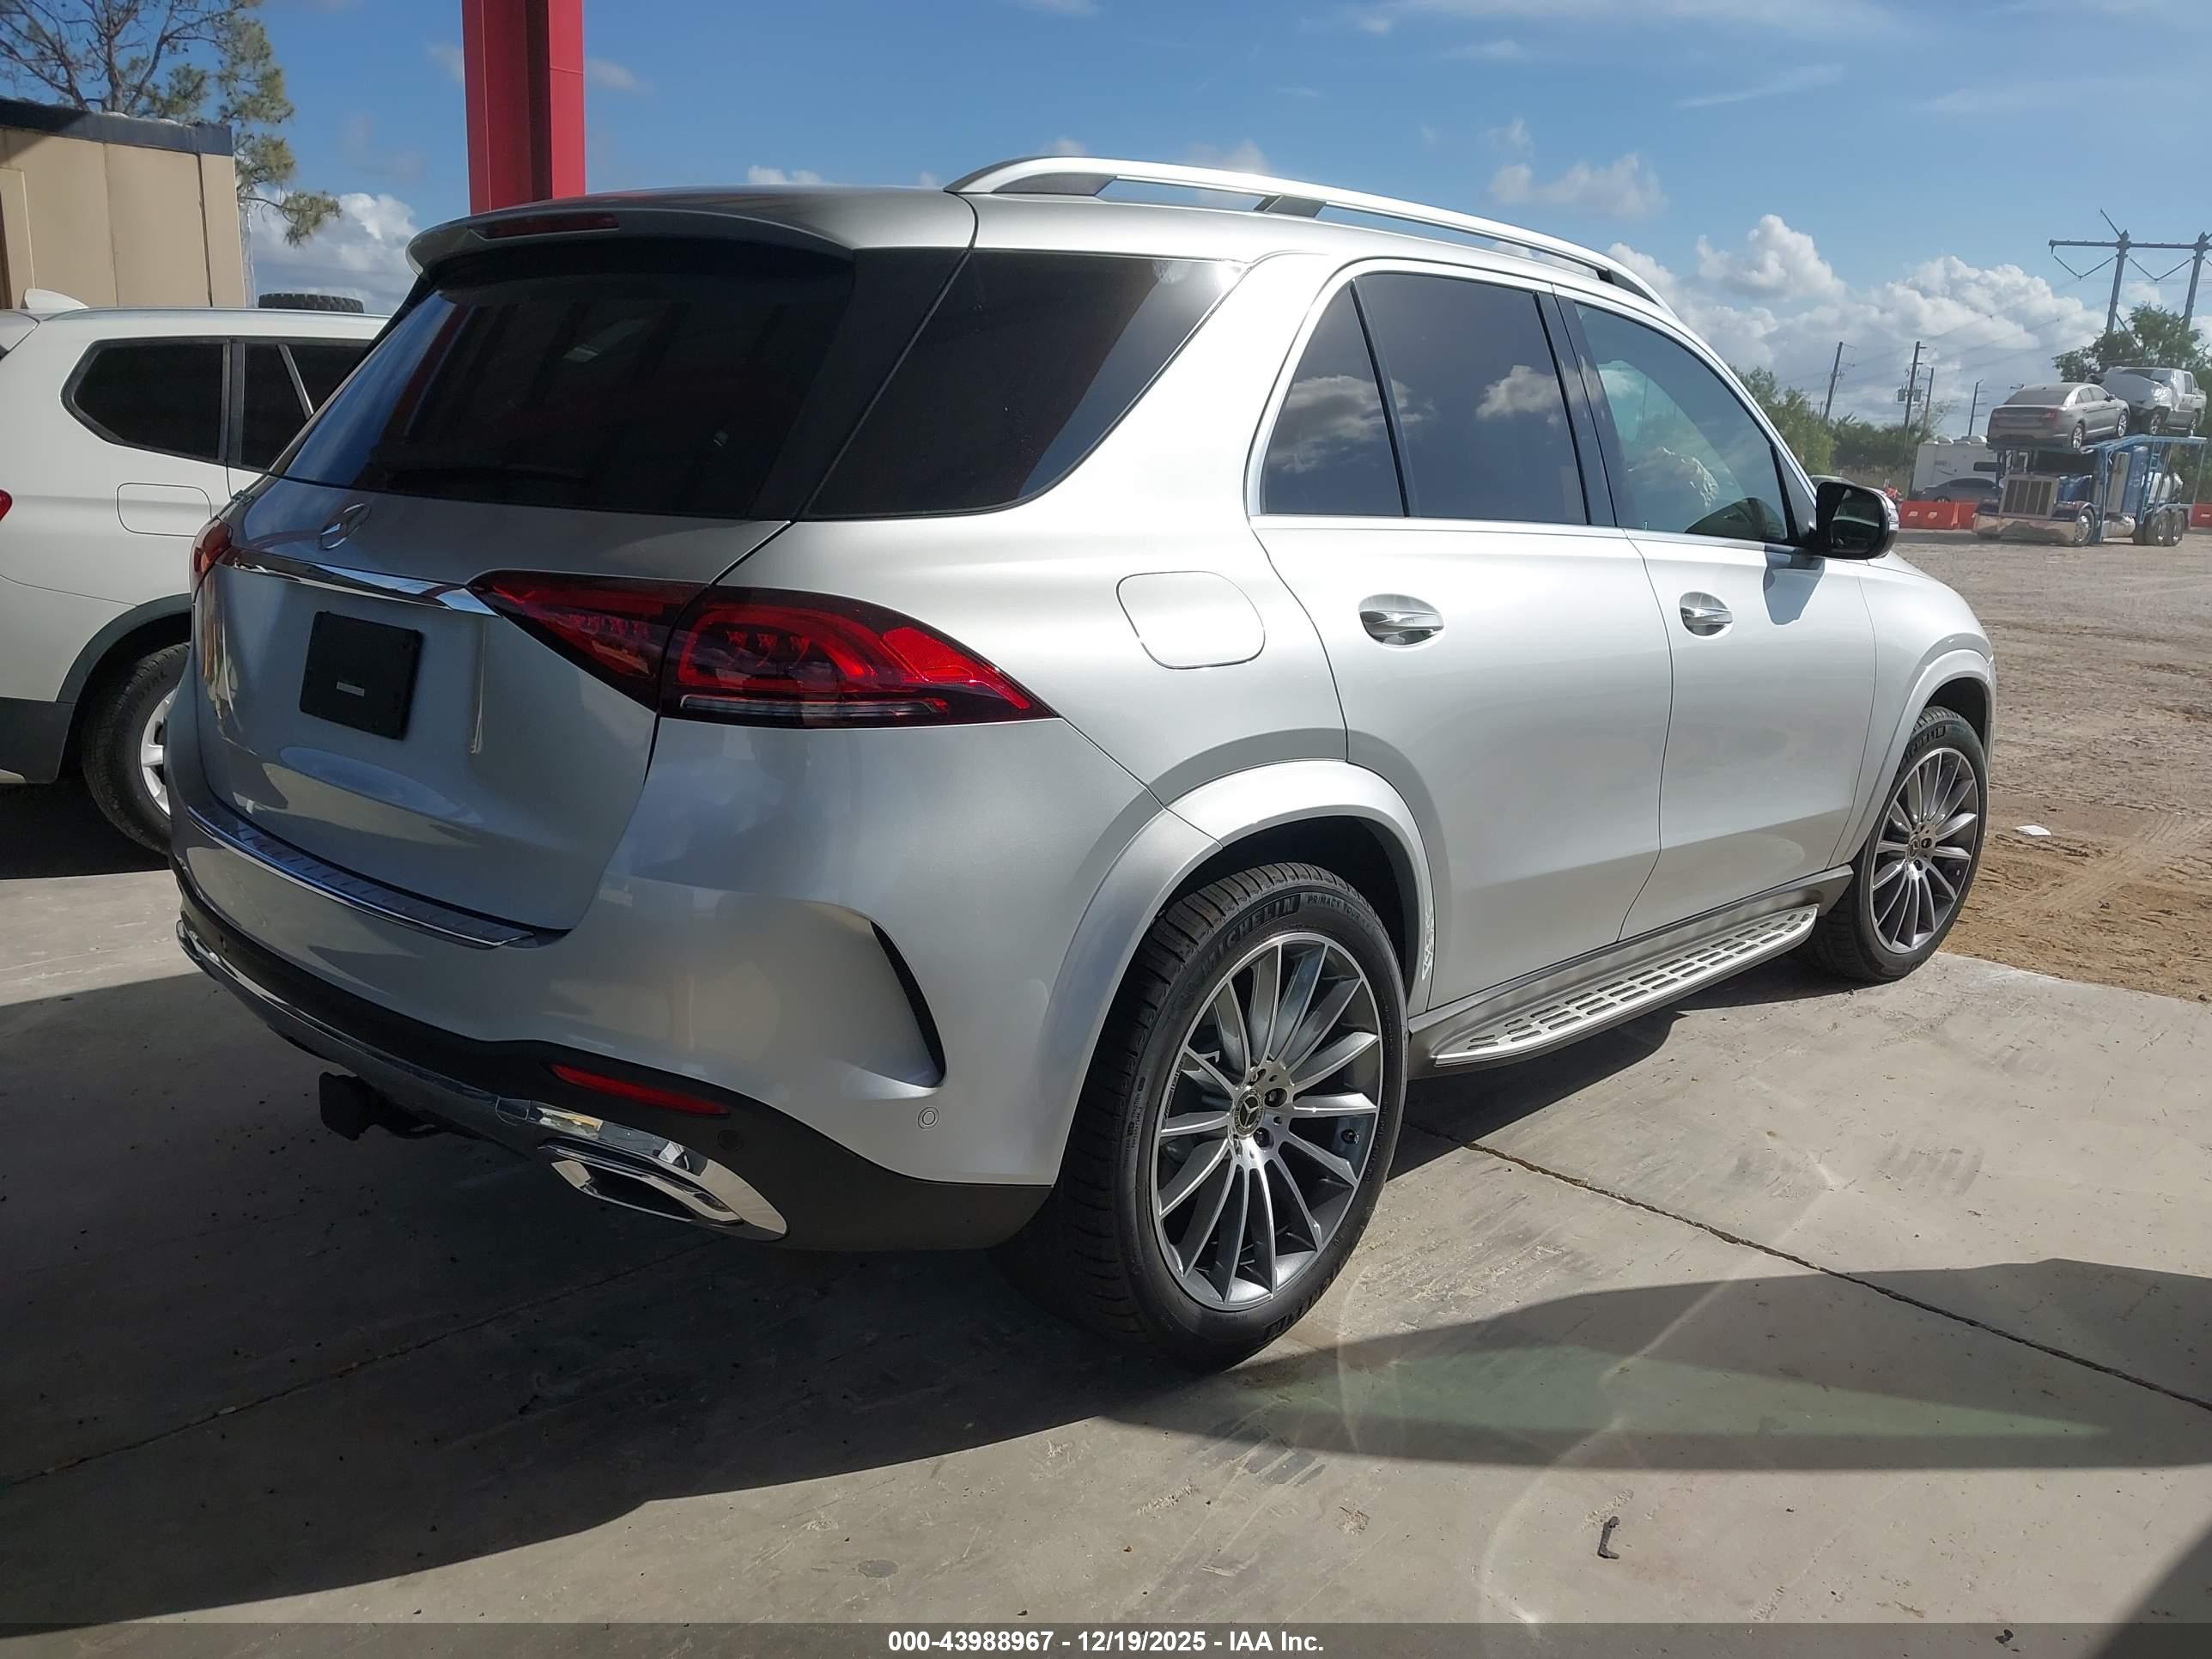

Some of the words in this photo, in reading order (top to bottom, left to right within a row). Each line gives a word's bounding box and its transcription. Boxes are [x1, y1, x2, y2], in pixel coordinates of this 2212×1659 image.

[1200, 894, 1295, 976] MICHELIN
[1307, 896, 1341, 908] PRIMACY
[1343, 904, 1361, 921] TOUR
